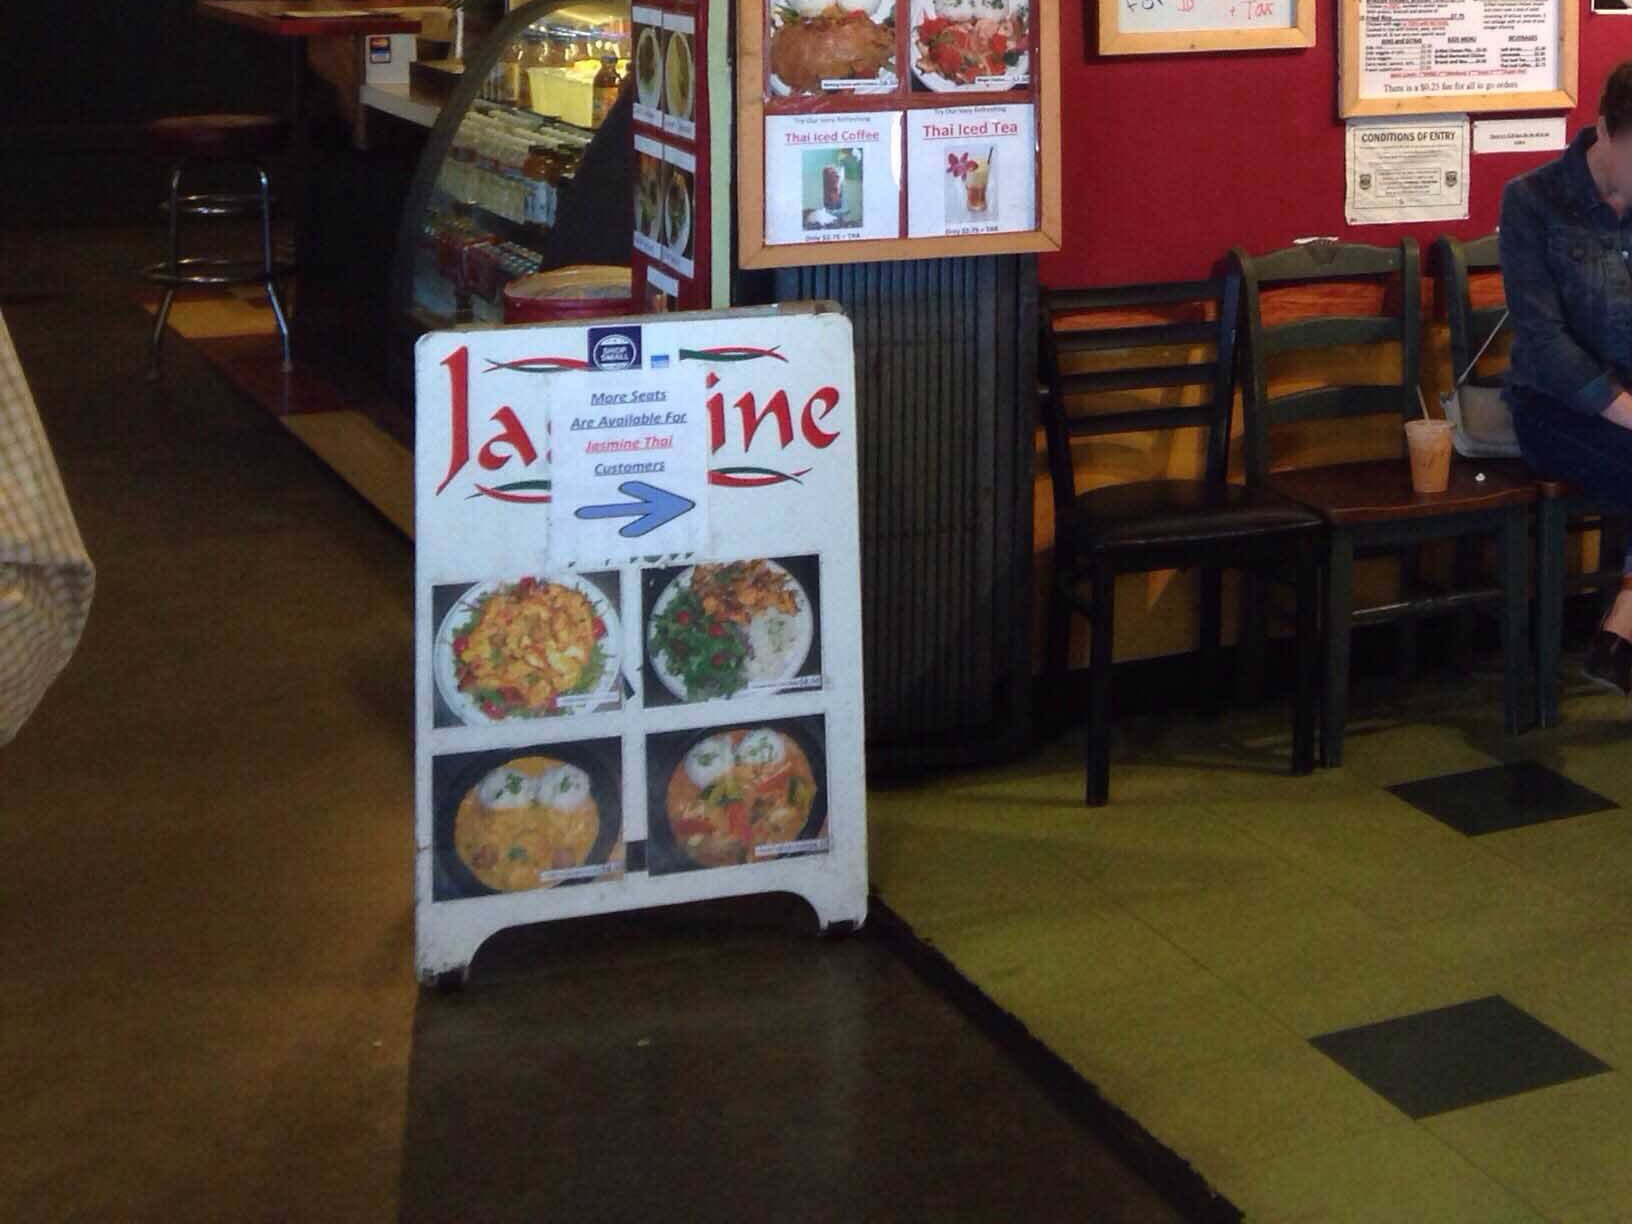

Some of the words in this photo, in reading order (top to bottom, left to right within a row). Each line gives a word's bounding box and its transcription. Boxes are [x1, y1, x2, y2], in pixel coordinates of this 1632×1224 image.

[785, 131, 811, 144] Thai
[813, 131, 838, 143] Iced
[841, 130, 880, 143] Coffee
[923, 124, 955, 138] Thai
[958, 123, 989, 137] Iced
[991, 121, 1018, 135] Tea
[1361, 131, 1416, 143] CONDITIONS
[1417, 131, 1428, 142] OF
[1429, 131, 1455, 141] ENTRY
[591, 392, 629, 406] More
[632, 390, 666, 402] Seats
[435, 344, 841, 496] Jaine
[570, 418, 595, 431] Are
[597, 413, 662, 428] Available
[665, 412, 688, 425] For
[586, 438, 641, 454] Jasmine
[645, 435, 673, 450] Thai
[594, 461, 665, 476] Customers
